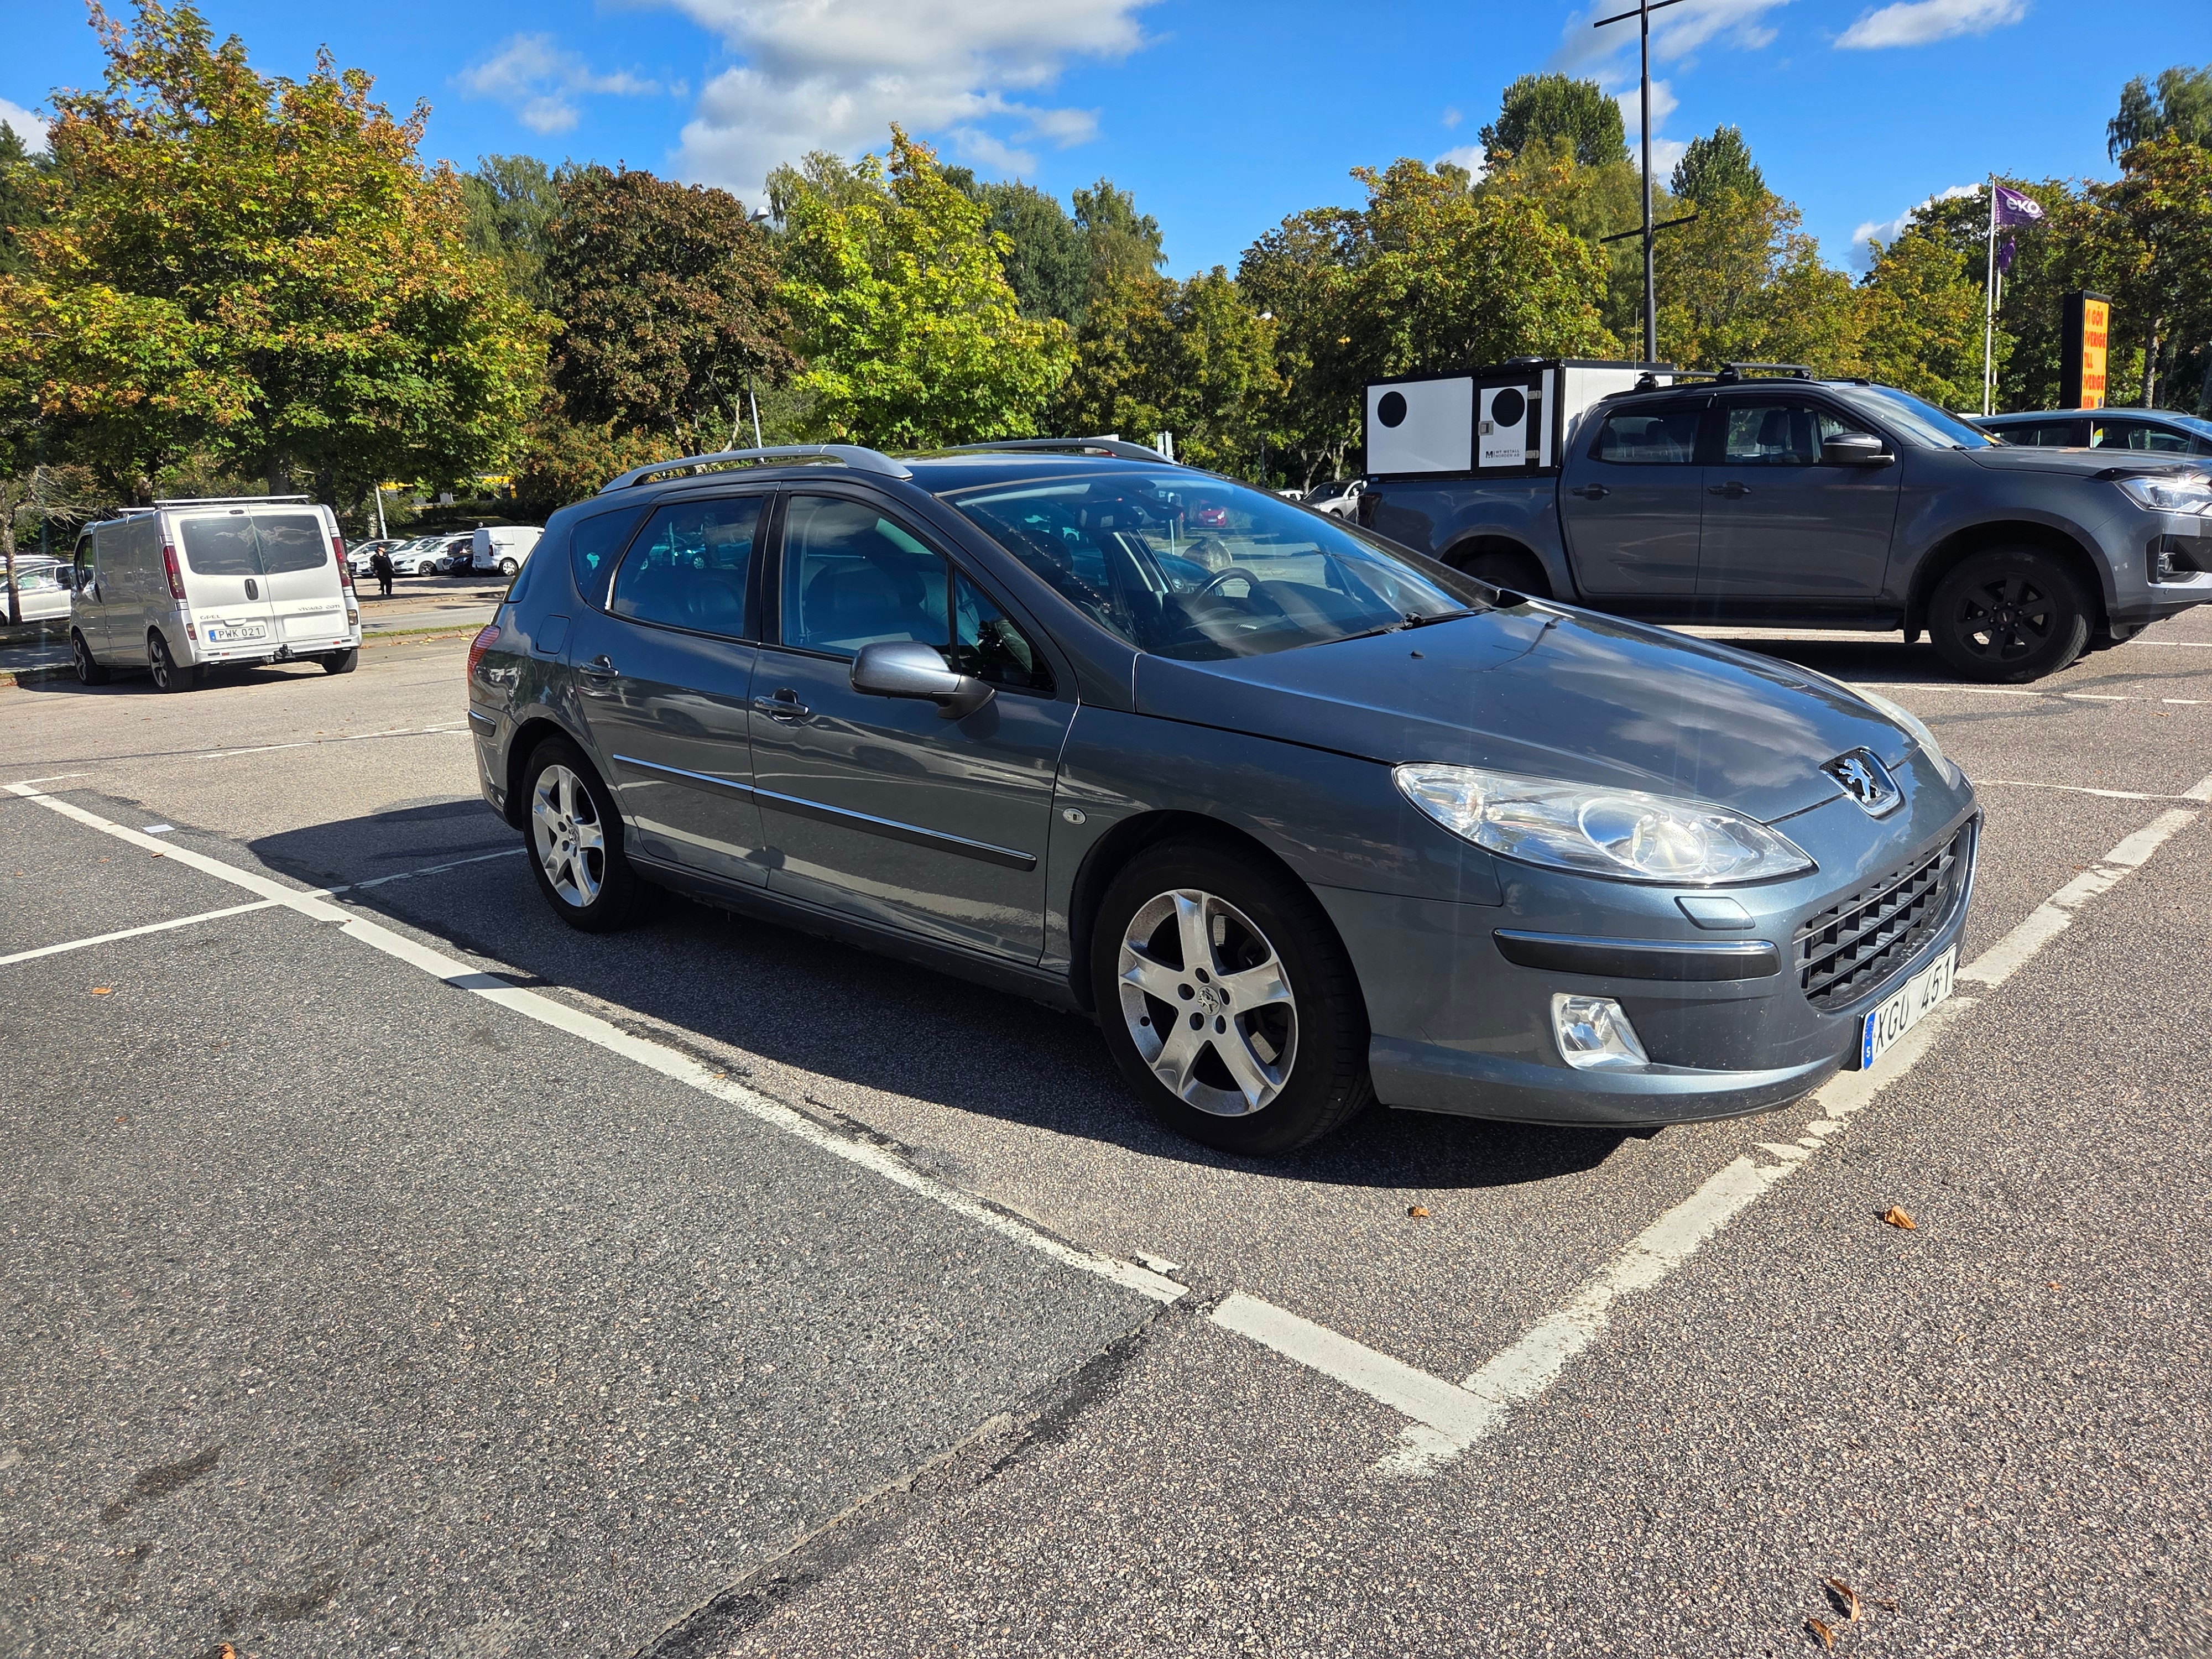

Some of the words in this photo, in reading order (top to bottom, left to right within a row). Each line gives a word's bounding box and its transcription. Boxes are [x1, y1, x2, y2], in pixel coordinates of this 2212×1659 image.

[2091, 305, 2103, 326] GÖR
[2085, 330, 2106, 348] SVERIGE
[2084, 352, 2093, 369] TILL
[2083, 374, 2105, 391] SVERIGE
[218, 629, 239, 638] PWK
[242, 628, 260, 636] 021
[1876, 993, 1909, 1053] XGU
[1921, 956, 1950, 1010] 451
[1866, 1046, 1870, 1058] S
